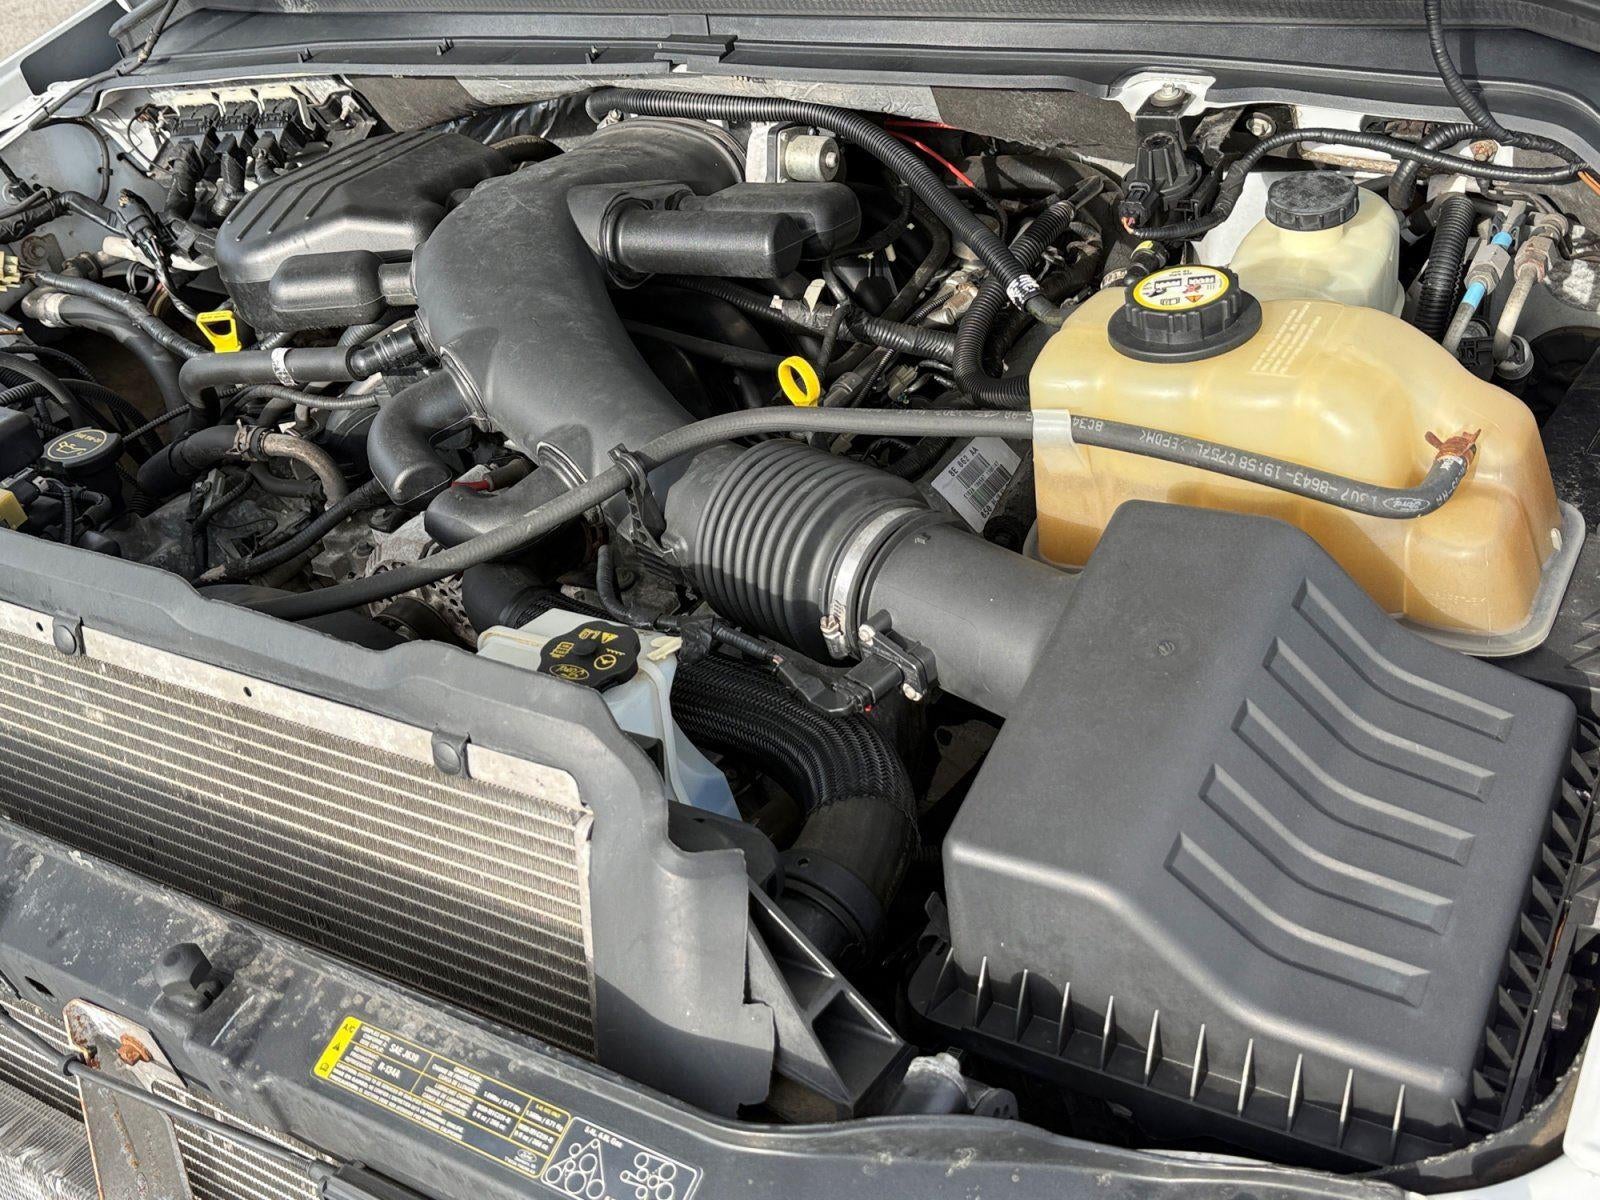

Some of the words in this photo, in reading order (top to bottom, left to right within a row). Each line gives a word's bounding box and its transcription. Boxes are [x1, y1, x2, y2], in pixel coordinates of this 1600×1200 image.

[1239, 456, 1282, 480] 19:58
[553, 664, 587, 680] Ford
[343, 1023, 356, 1034] A/C
[388, 1043, 404, 1056] SAE
